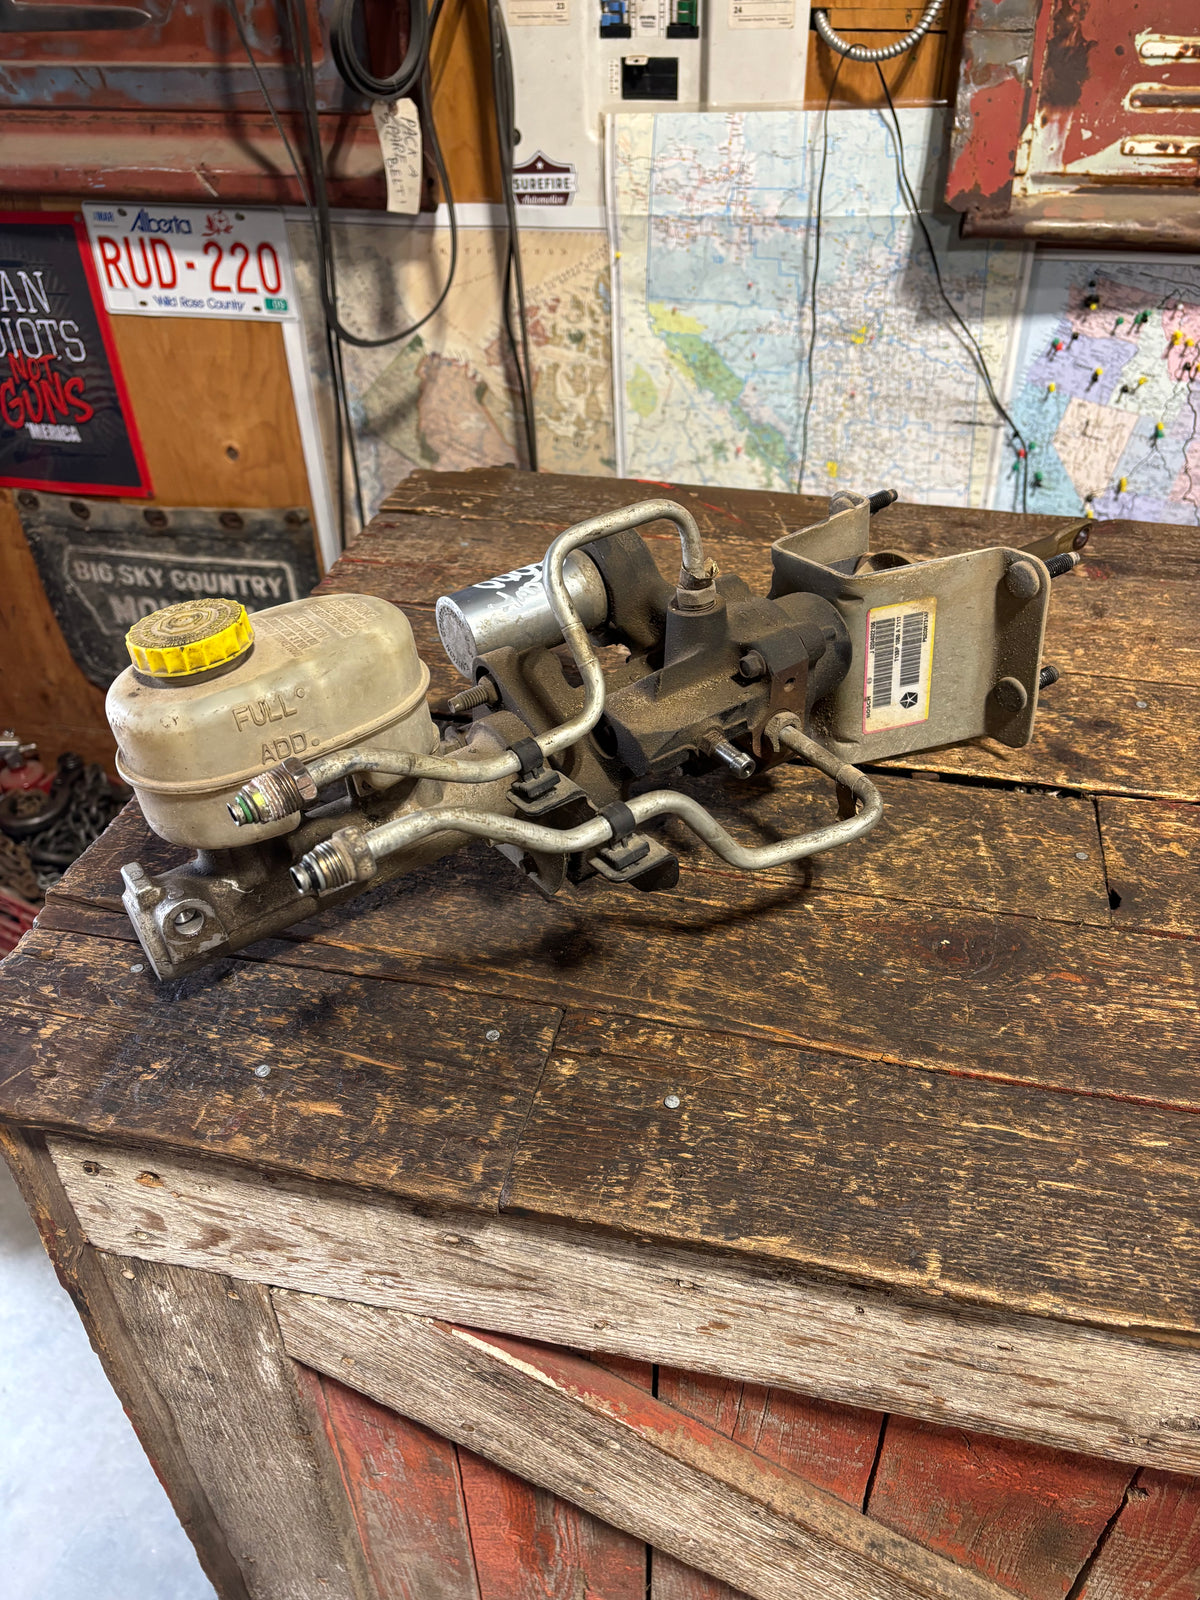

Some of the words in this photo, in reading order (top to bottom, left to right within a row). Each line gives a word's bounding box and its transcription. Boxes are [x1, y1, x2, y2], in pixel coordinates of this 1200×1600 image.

[512, 177, 570, 190] SUREFIRE
[130, 207, 193, 235] Alberta
[152, 294, 178, 308] Wild
[179, 295, 205, 309] Rose
[206, 297, 246, 312] Country
[7, 348, 57, 385] NOT
[0, 371, 94, 429] GUNS
[72, 561, 115, 584] BIG
[117, 566, 166, 589] SKY
[170, 569, 284, 600] COUNTRY
